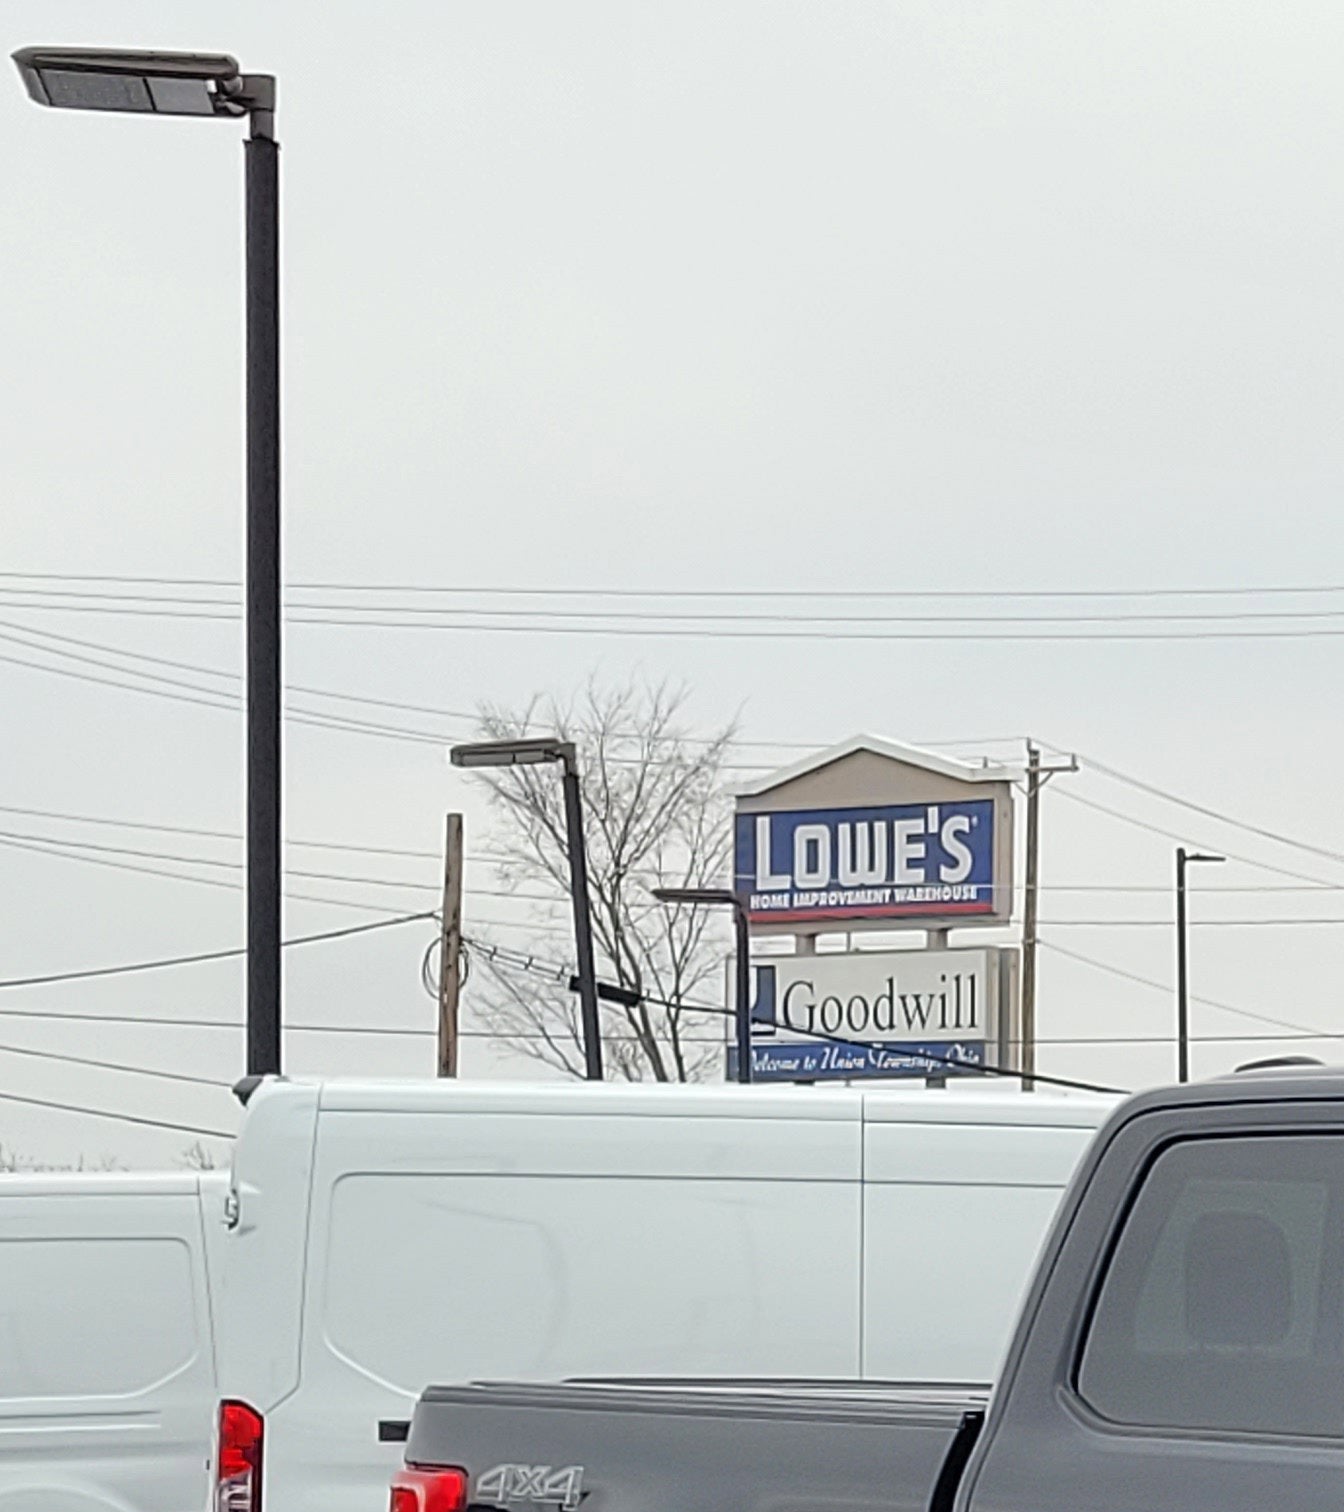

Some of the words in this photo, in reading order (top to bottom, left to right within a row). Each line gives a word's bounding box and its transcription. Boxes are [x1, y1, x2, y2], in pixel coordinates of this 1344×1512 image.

[755, 806, 974, 891] LOWE'S
[750, 893, 789, 910] HOME
[793, 888, 892, 907] IMPROVEMENT
[893, 885, 978, 902] WAREHOUSE
[782, 973, 978, 1033] Goodwill
[803, 1055, 817, 1070] to
[821, 1047, 865, 1069] Union
